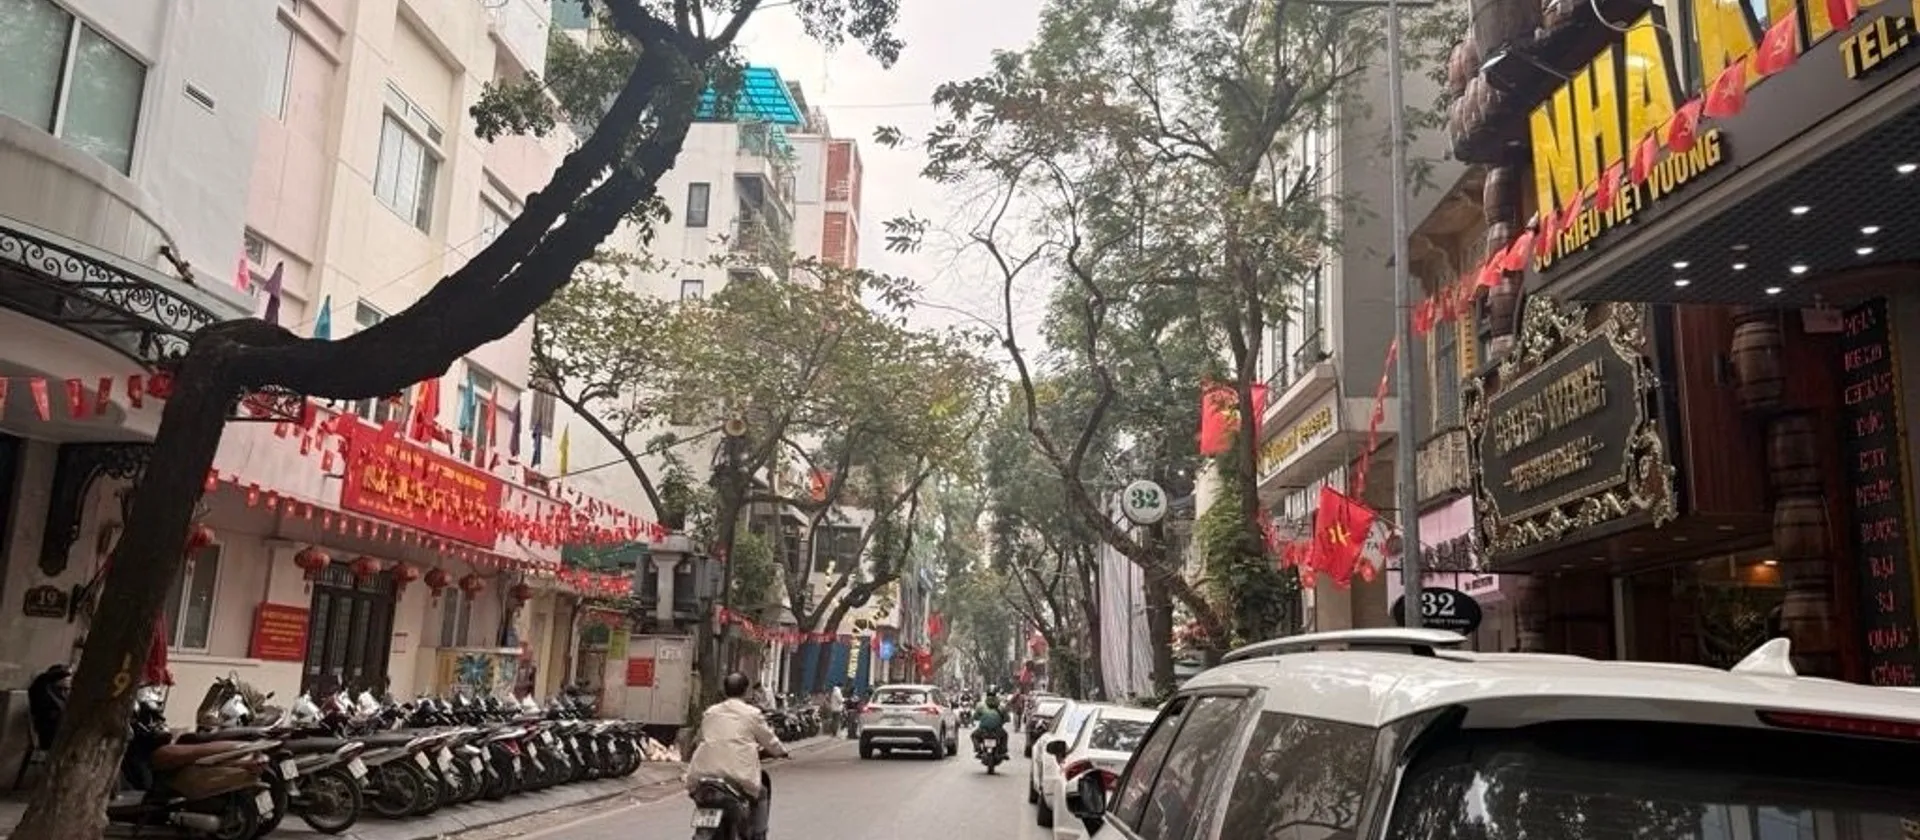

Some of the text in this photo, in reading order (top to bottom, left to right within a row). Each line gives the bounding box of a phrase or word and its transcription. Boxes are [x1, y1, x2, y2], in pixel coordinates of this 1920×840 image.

[1839, 15, 1909, 79] TEL:
[1131, 489, 1160, 509] 32
[1421, 592, 1456, 616] 32
